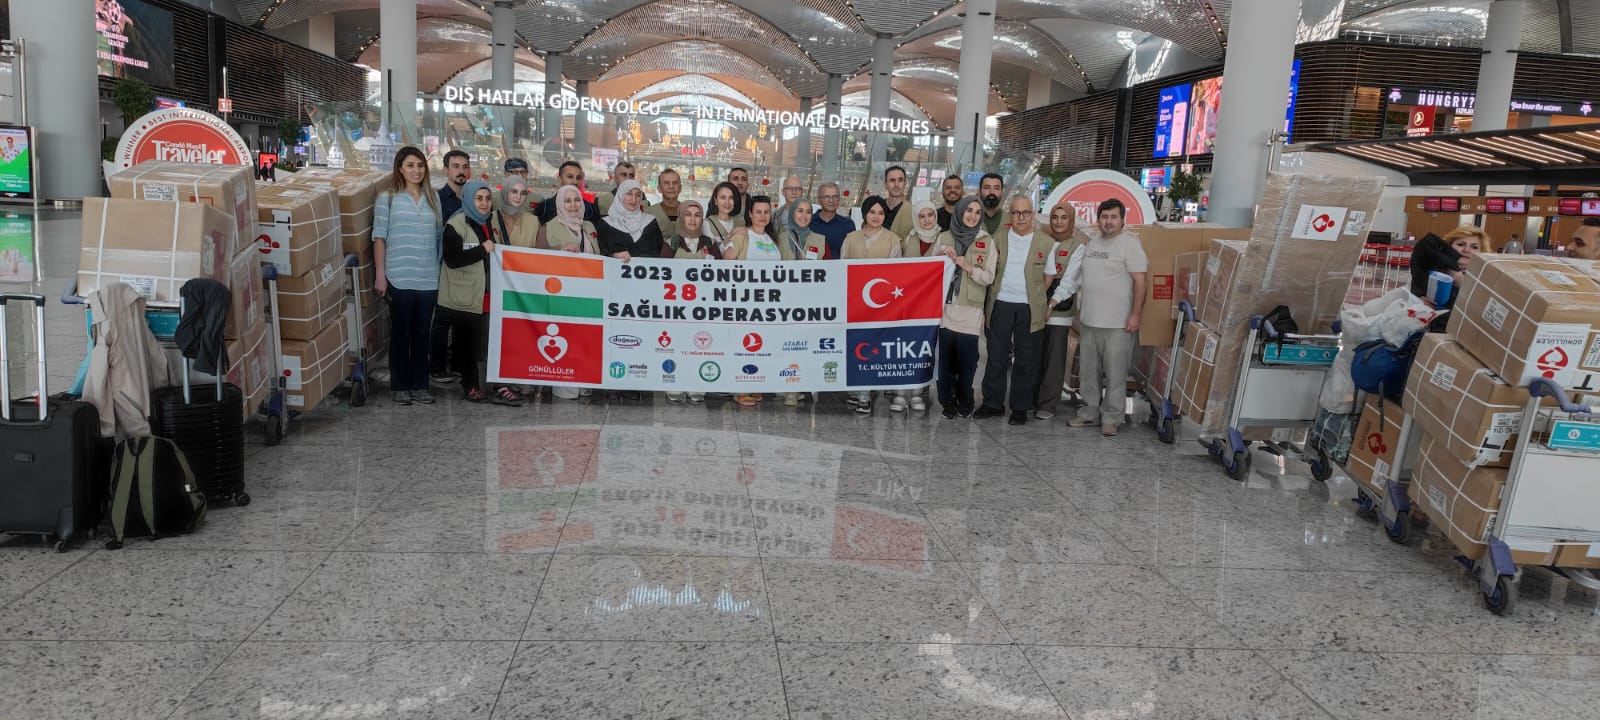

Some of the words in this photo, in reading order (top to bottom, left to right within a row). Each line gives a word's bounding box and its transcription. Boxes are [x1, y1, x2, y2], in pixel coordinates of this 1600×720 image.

[445, 85, 474, 105] DIŞ
[478, 88, 545, 107] HATLAR
[606, 98, 661, 115] YOLCU
[1418, 92, 1476, 109] HUNGRY?
[697, 104, 824, 129] INTERNATIONAL
[829, 113, 930, 135] DEPARTURES
[123, 130, 142, 160] WINNER
[148, 114, 166, 127] BEST
[151, 140, 227, 164] Traveler
[620, 264, 673, 281] 2023
[685, 263, 827, 283] GÖNÜLLÜLER
[713, 284, 782, 302] NİJER
[607, 299, 687, 320] SAĞLIK
[692, 306, 838, 322] OPERASYONU
[881, 337, 933, 359] TİKA
[528, 365, 574, 375] GÖNÜLLÜLER
[779, 368, 797, 377] dost
[870, 362, 897, 370] KÜLTÜR
